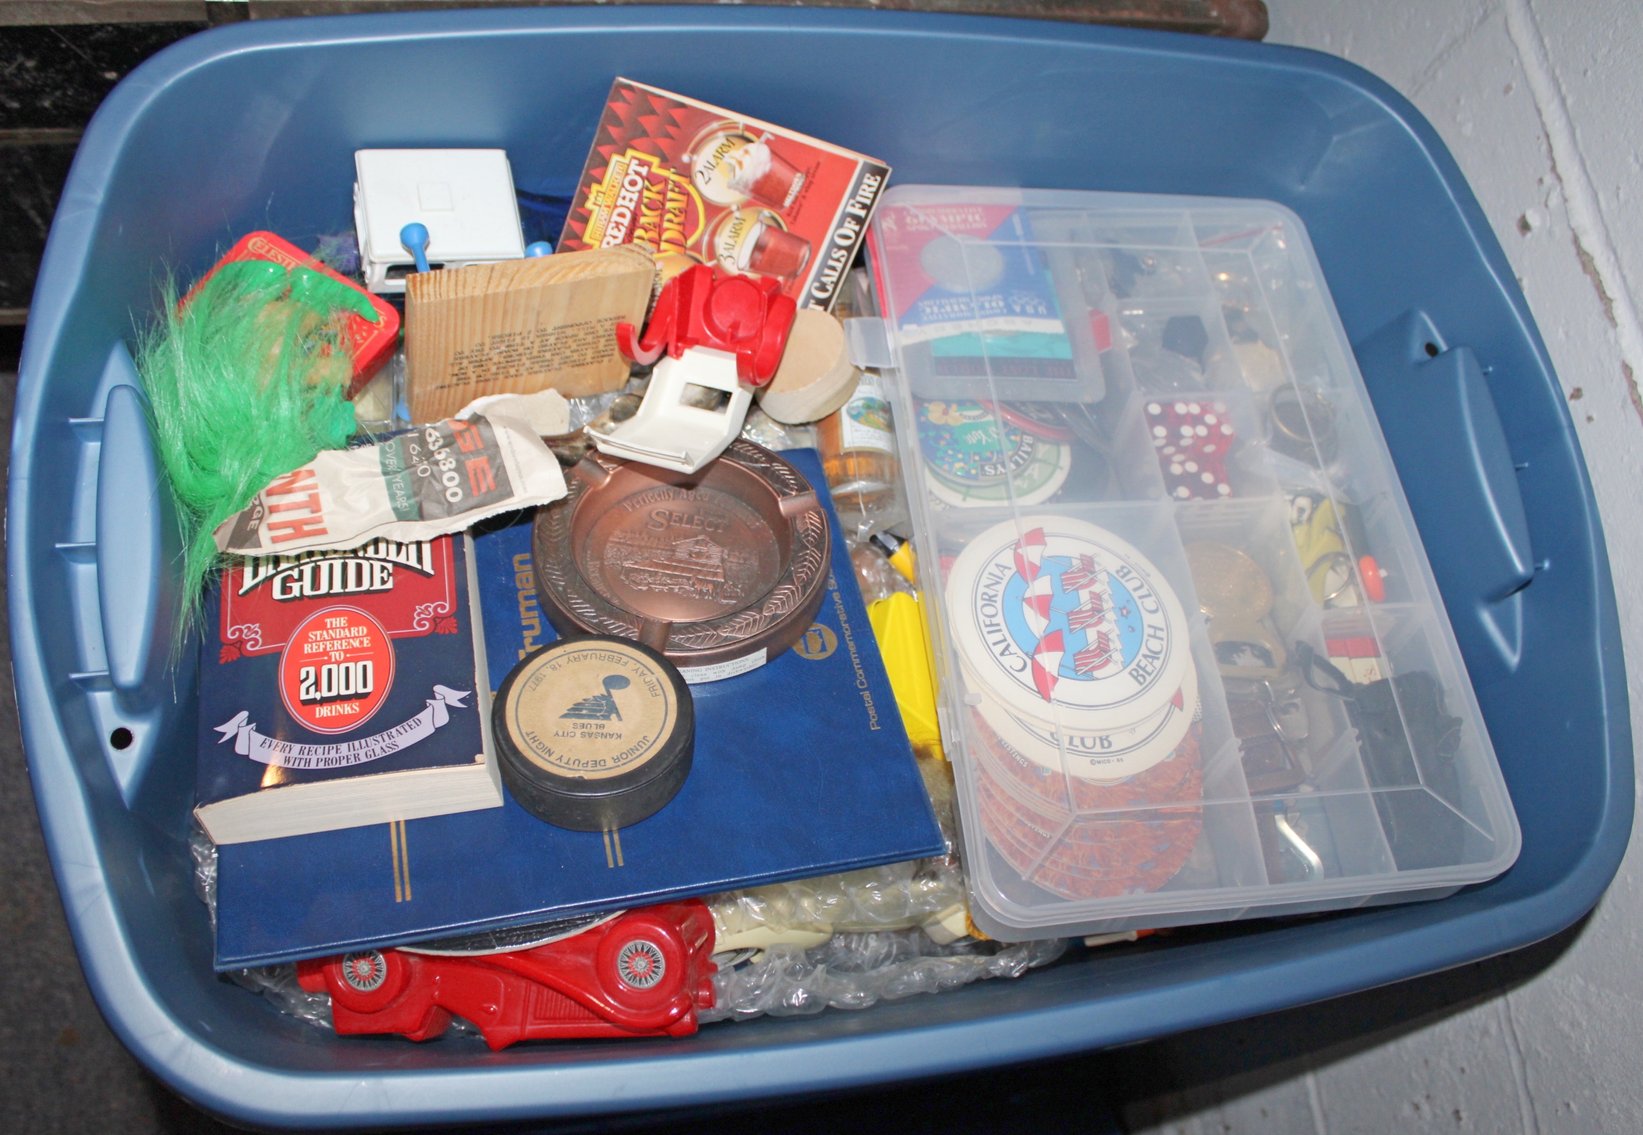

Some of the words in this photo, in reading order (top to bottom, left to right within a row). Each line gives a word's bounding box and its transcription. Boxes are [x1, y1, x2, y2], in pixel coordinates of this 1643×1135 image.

[600, 159, 648, 249] REDHOT
[633, 178, 665, 246] BACK
[661, 167, 692, 253] DRAFT
[811, 246, 849, 299] CALLS
[834, 216, 861, 247] OF
[850, 172, 881, 217] FIRE
[271, 558, 394, 600] GUIDE
[1116, 564, 1160, 614] CLUB
[325, 617, 348, 628] THE
[980, 562, 1028, 673] CALIFORNIA
[304, 637, 371, 654] REFERENCE
[308, 626, 368, 643] STANDARD
[832, 591, 868, 688] Commemorative
[329, 651, 344, 661] TO
[566, 652, 629, 667] FEBRUARY
[1129, 625, 1165, 686] BEACH
[299, 660, 374, 702] 2,000
[529, 673, 547, 693] 1977
[315, 702, 360, 718] DRINKS
[861, 694, 881, 731] Postal
[259, 737, 294, 756] EVERY
[298, 744, 342, 757] RECIPE
[347, 717, 423, 755] ILLUSTRATED
[553, 730, 577, 739] CITY
[572, 722, 605, 730] BLUES
[580, 731, 623, 740] KANSAS
[283, 755, 312, 768] WITH
[315, 753, 361, 768] PROPER
[364, 741, 400, 759] GLASS
[525, 730, 554, 757] NIGHT
[612, 735, 651, 764] JUNIOR
[556, 755, 606, 768] DEPUTY
